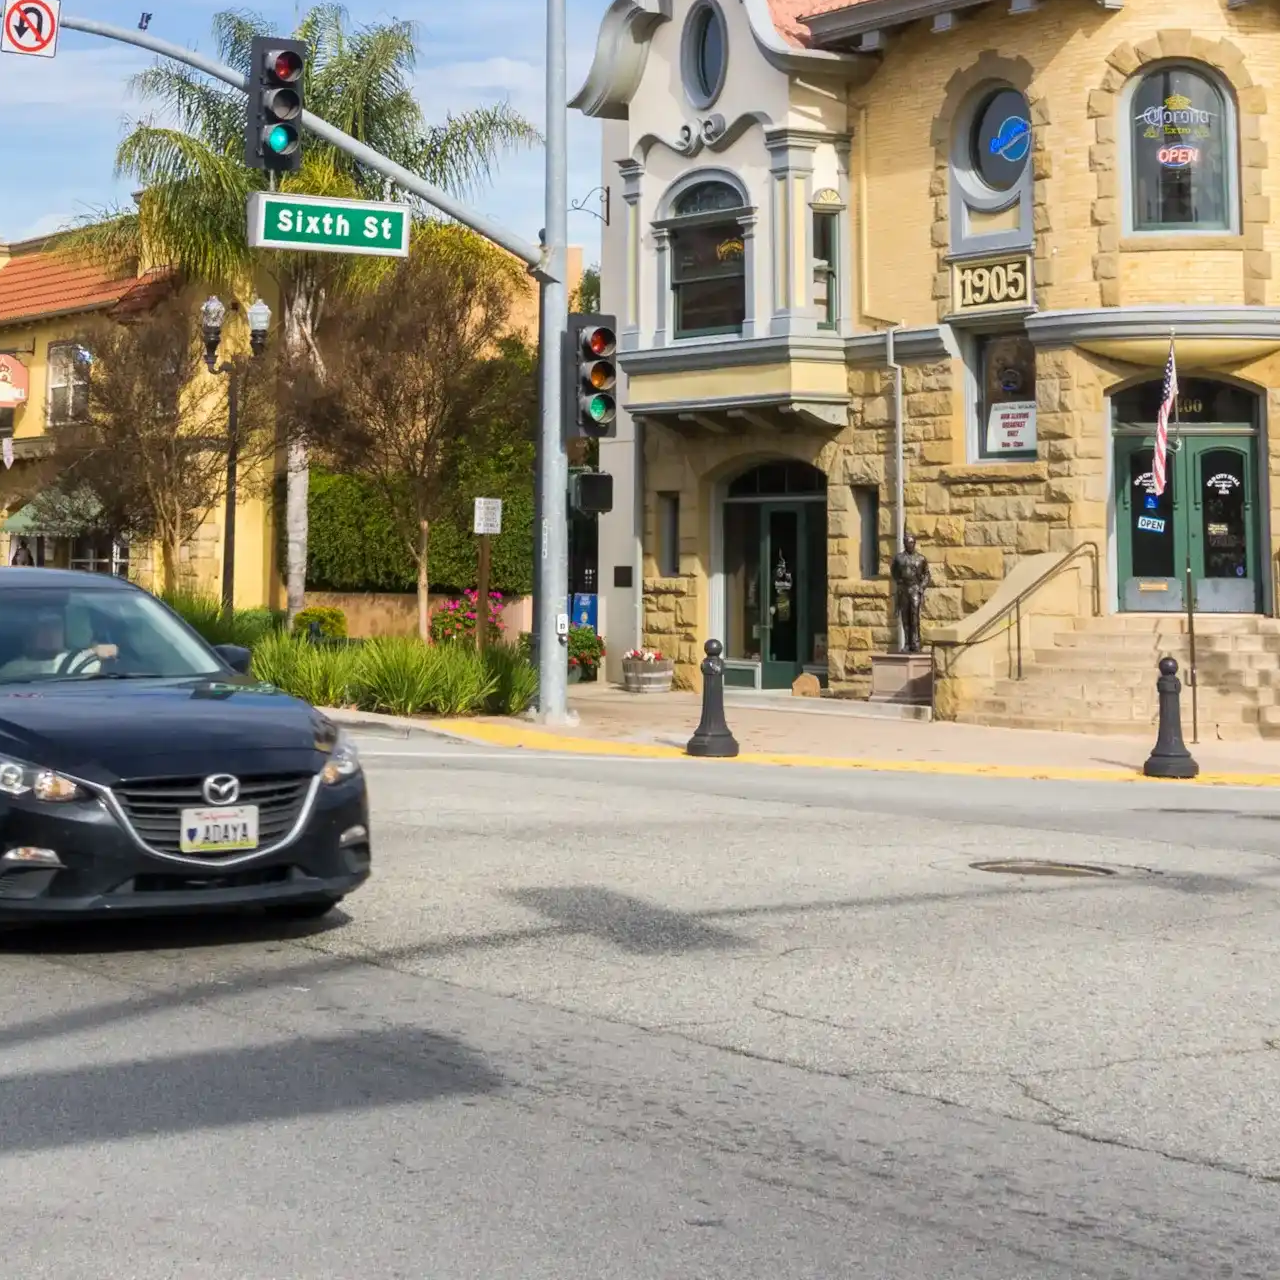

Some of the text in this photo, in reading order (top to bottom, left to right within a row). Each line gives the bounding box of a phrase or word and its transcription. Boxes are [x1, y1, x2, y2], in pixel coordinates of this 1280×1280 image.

[1144, 106, 1209, 128] Corona
[1158, 148, 1198, 163] OPEN
[277, 209, 392, 240] Sixth St
[961, 263, 1025, 305] 1905
[1140, 518, 1163, 530] OPEN
